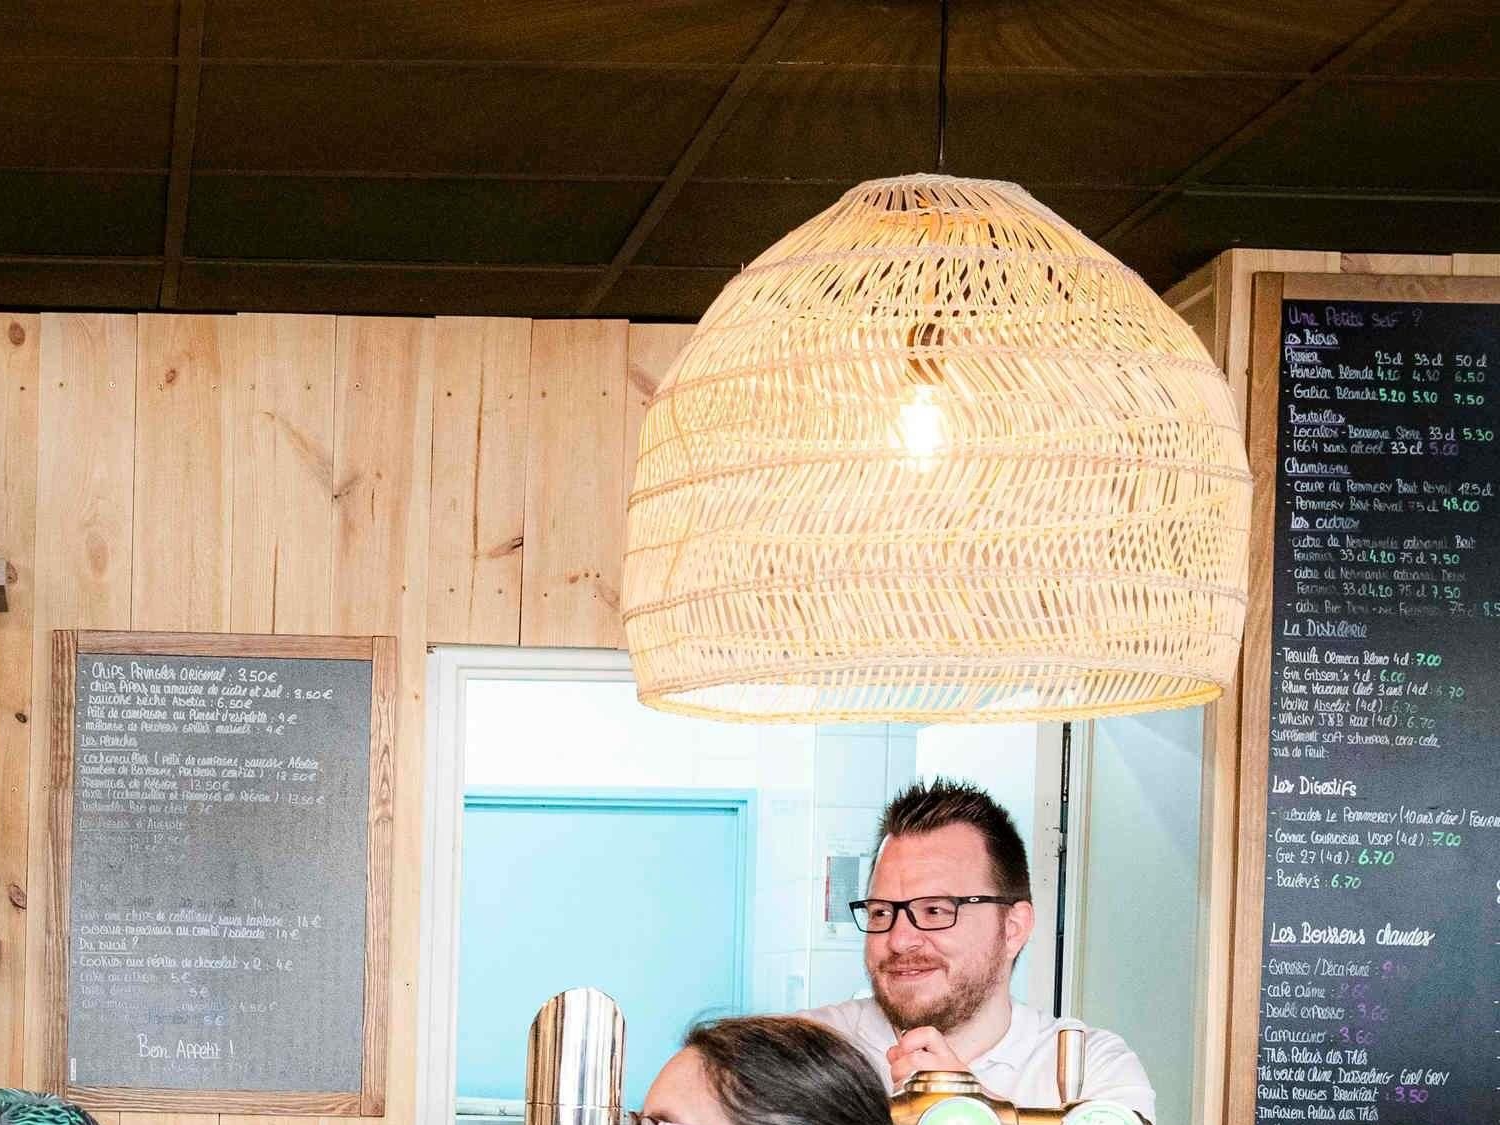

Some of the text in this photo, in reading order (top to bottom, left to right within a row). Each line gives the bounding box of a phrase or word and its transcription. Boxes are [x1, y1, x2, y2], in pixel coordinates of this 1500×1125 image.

[1379, 387, 1407, 403] 5.20
[1454, 392, 1485, 406] 7.50
[1463, 427, 1495, 442] 5.30
[1293, 439, 1319, 454] 1664
[1390, 441, 1408, 455] 33
[1443, 497, 1481, 513] 48.00
[1339, 548, 1356, 562] 33
[1369, 549, 1397, 565] 4.20
[1430, 552, 1461, 566] 7.50
[1368, 582, 1394, 598] 4.20
[1431, 585, 1462, 600] 7.50
[1283, 619, 1302, 637] La
[1416, 653, 1442, 668] 7.00
[1275, 846, 1295, 864] Get
[1300, 850, 1316, 863] 27
[1357, 849, 1394, 865] 6.70
[1330, 873, 1361, 889] 6.70
[1269, 922, 1297, 945] Les
